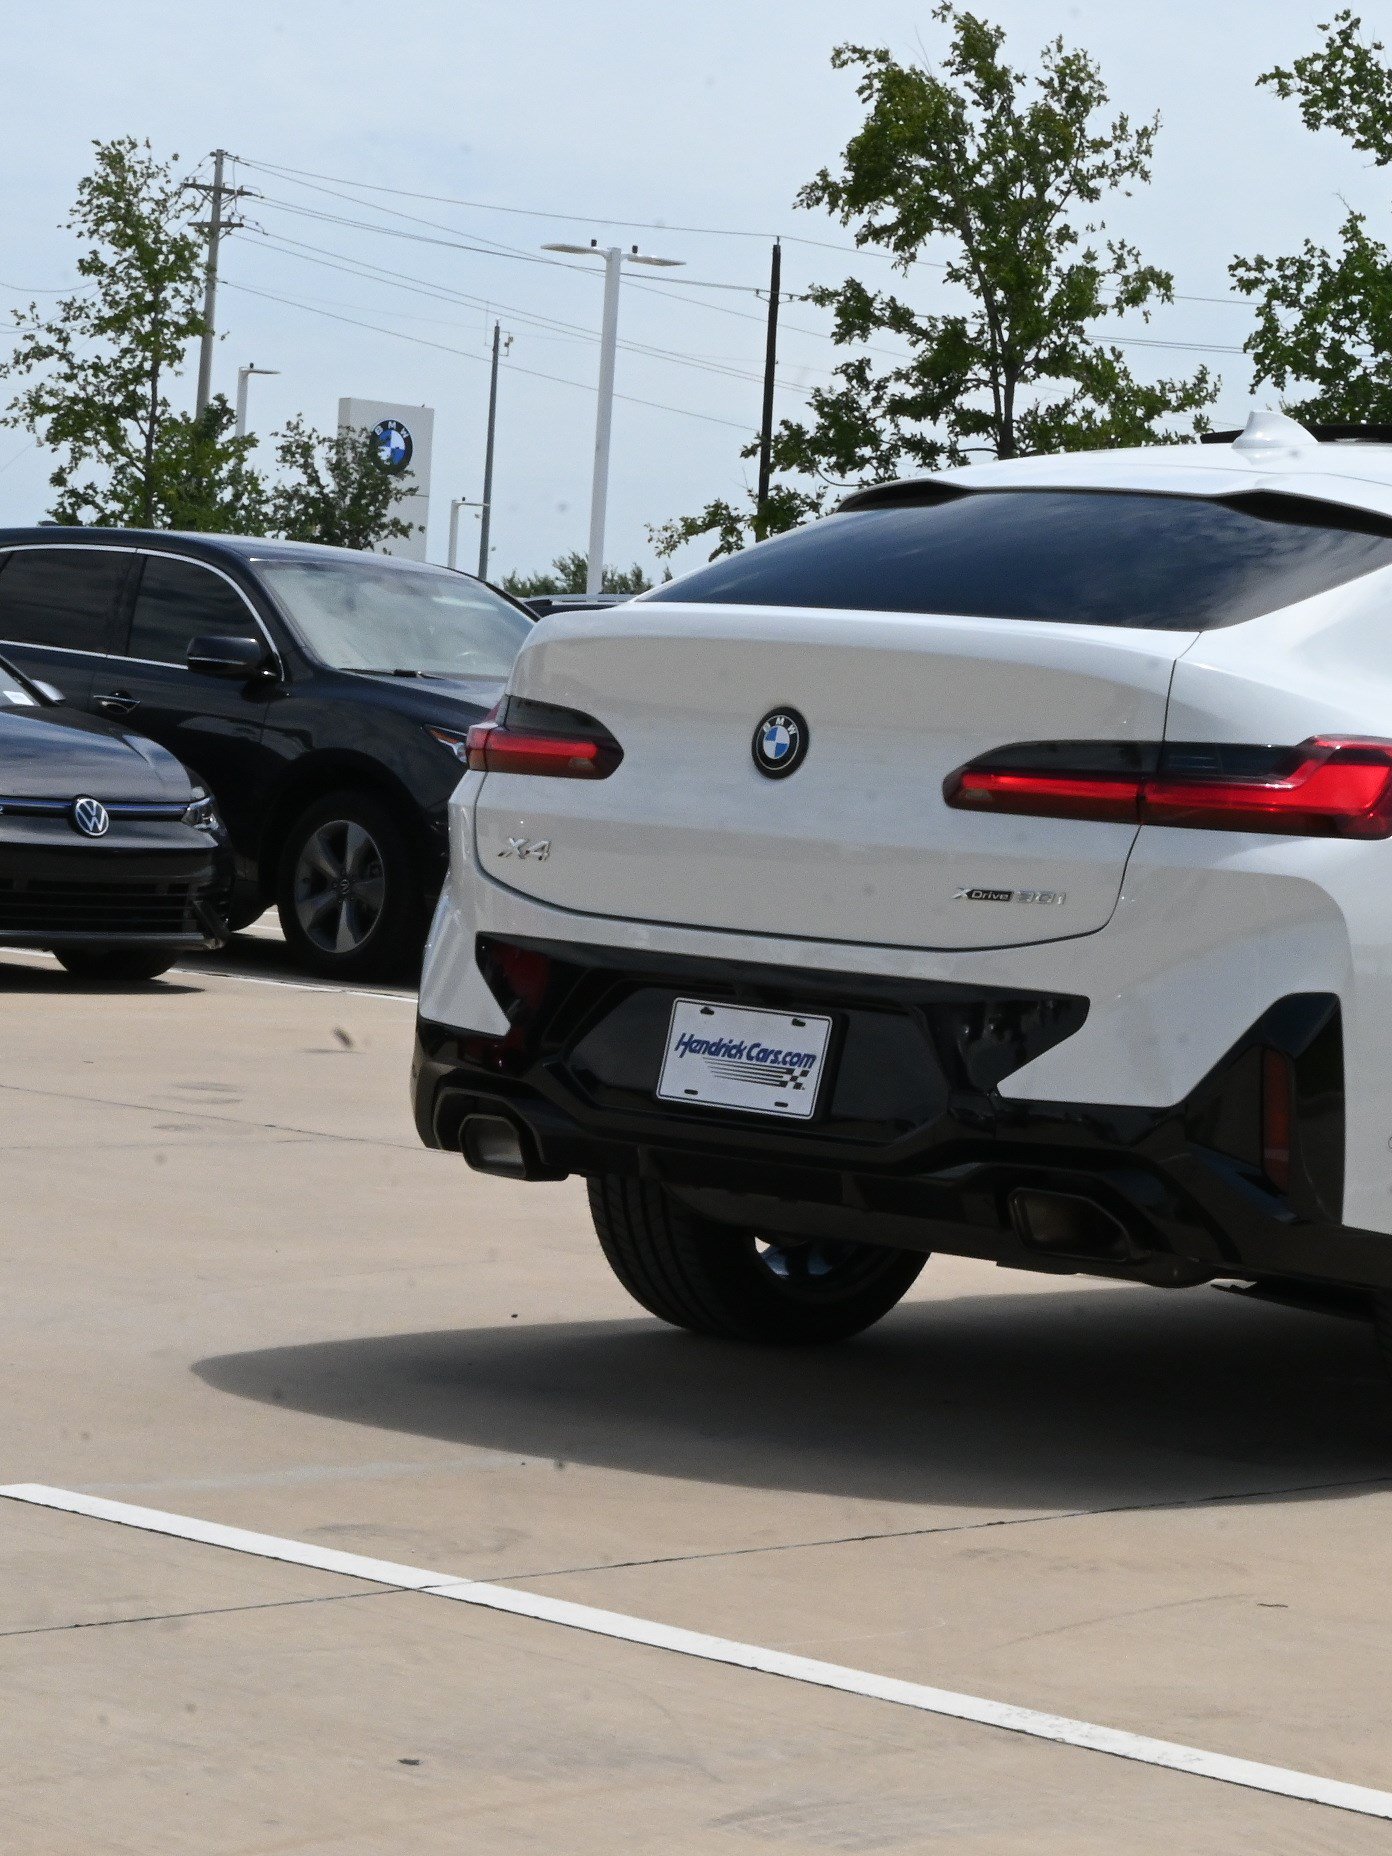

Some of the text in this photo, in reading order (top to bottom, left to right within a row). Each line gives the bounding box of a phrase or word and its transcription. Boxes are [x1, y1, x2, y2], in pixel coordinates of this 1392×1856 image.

[375, 420, 410, 439] BMW
[763, 716, 797, 735] BMW
[497, 835, 551, 861] X4
